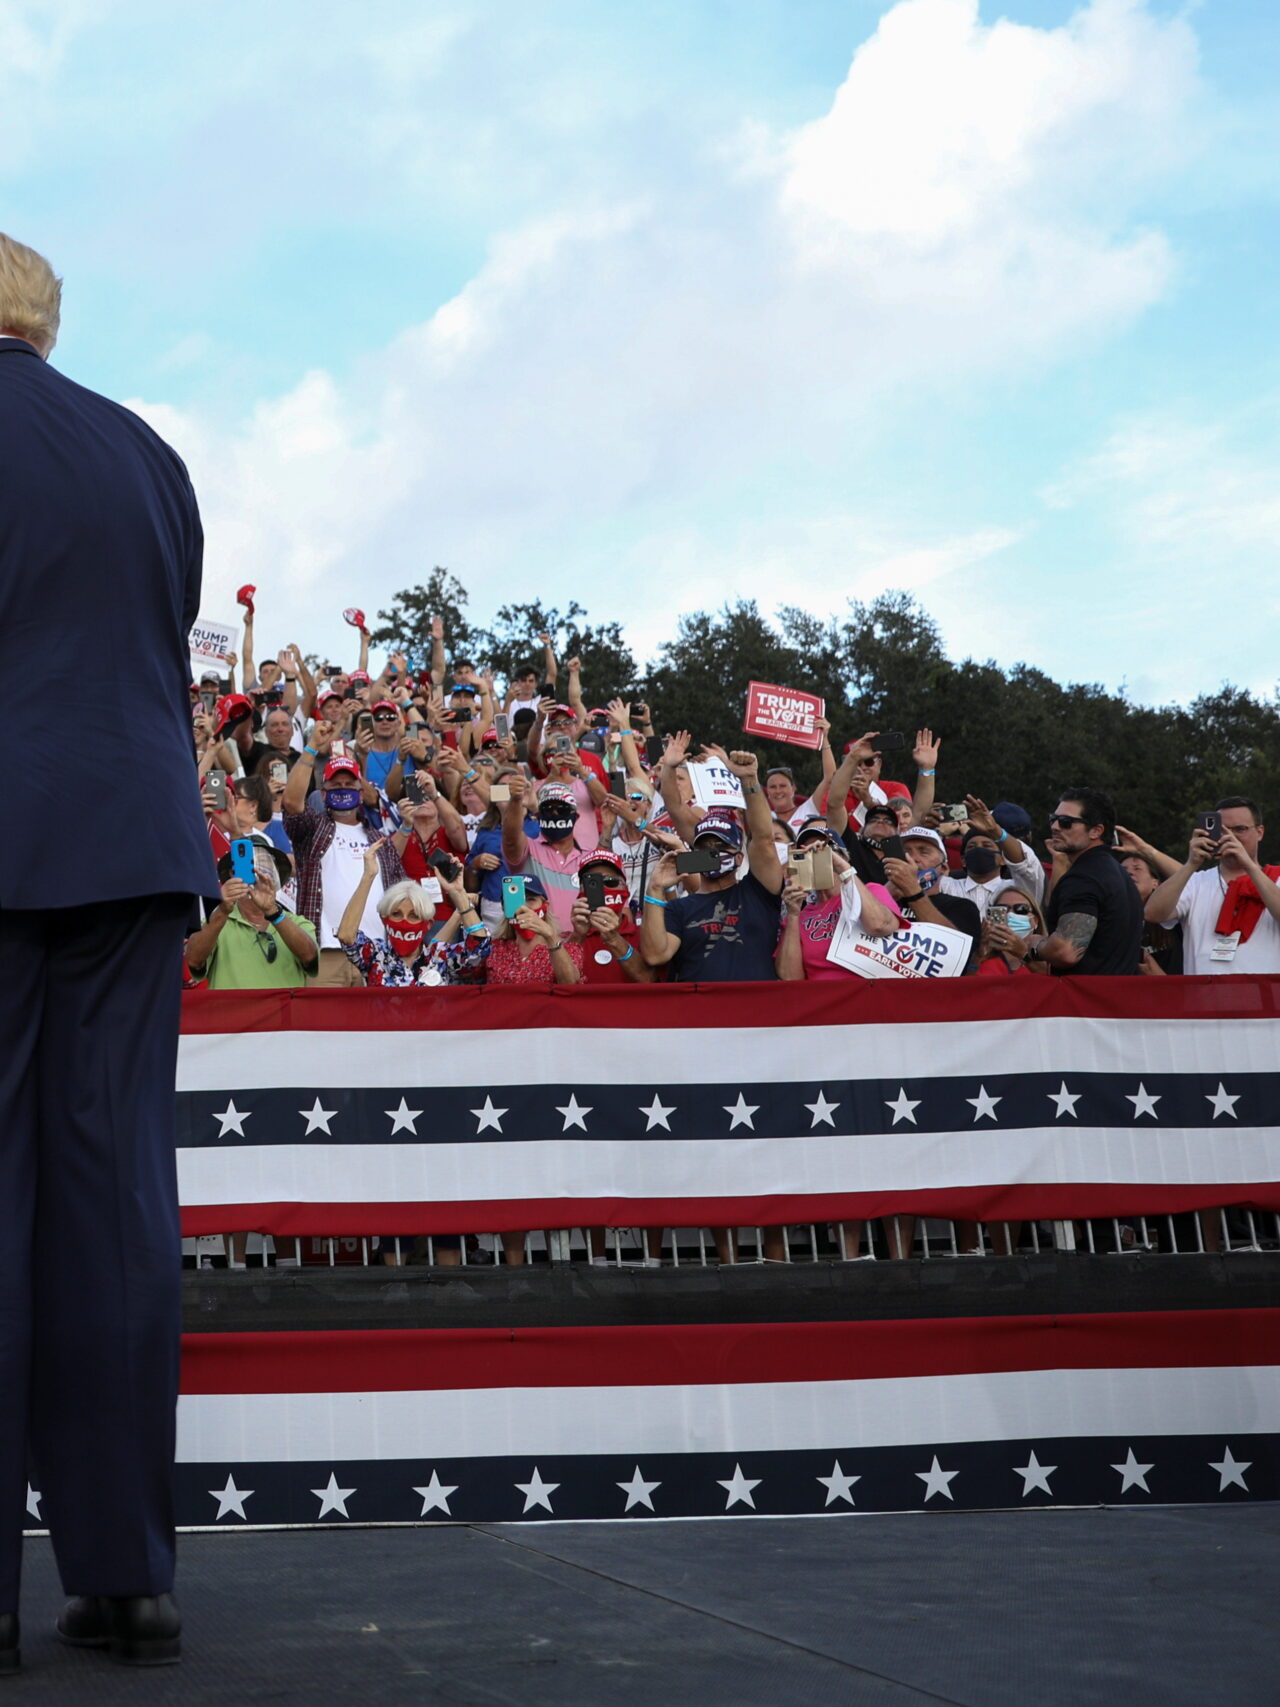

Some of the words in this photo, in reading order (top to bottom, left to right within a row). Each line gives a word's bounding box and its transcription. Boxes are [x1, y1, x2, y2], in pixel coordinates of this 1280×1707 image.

[192, 629, 228, 643] RUMP
[195, 639, 227, 655] VOTE
[757, 692, 815, 713] TRUMP
[770, 706, 816, 727] VOTE
[539, 819, 573, 829] MAGA
[696, 820, 732, 832] TRUMP
[604, 894, 623, 905] GA
[860, 933, 879, 945] THE
[881, 938, 943, 977] VOTE
[869, 952, 898, 972] EARLY
